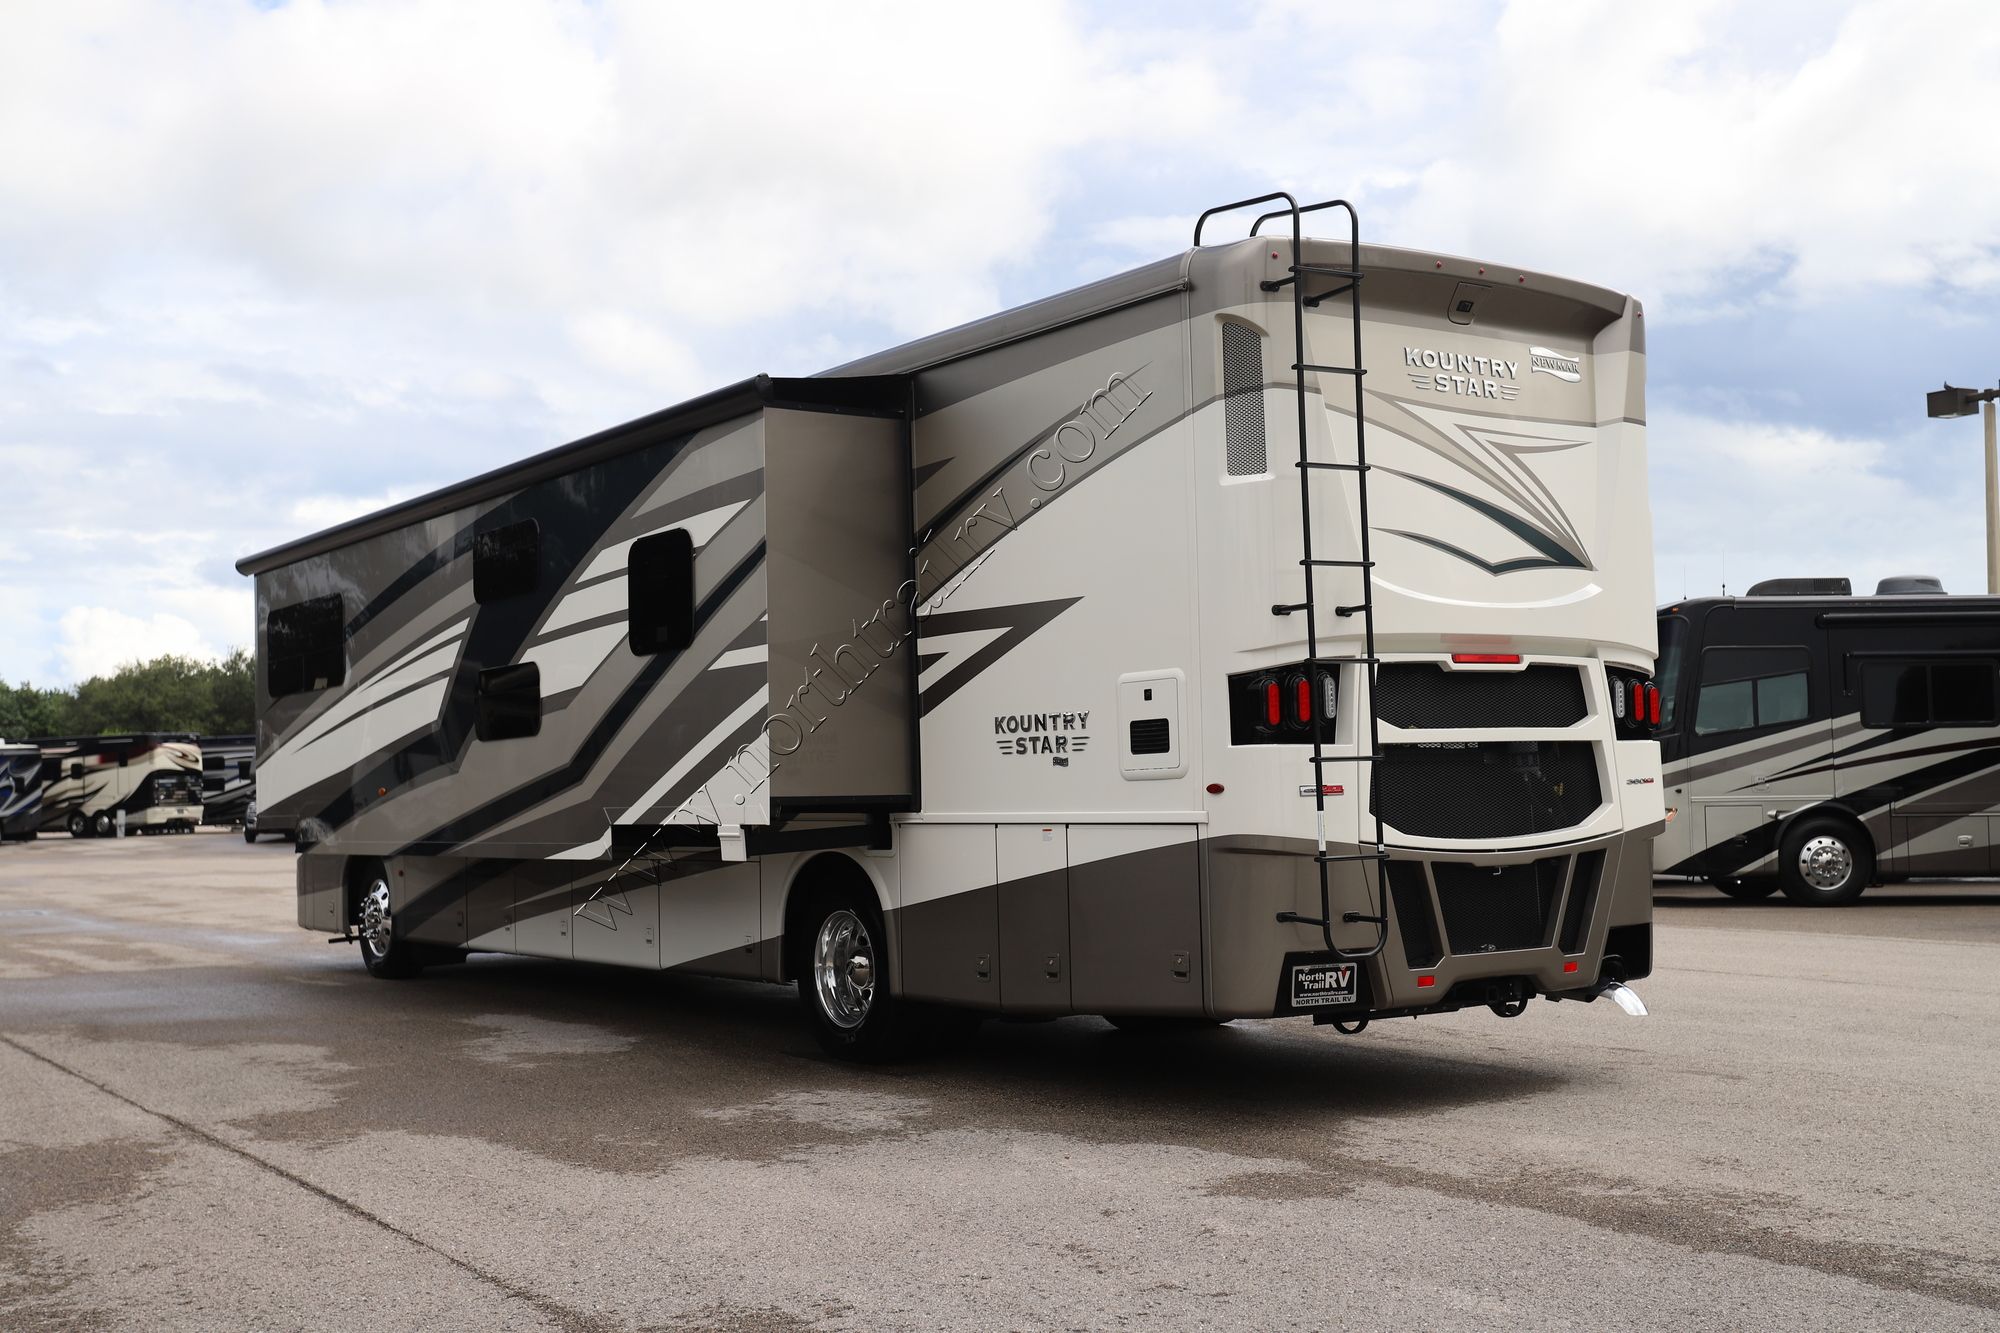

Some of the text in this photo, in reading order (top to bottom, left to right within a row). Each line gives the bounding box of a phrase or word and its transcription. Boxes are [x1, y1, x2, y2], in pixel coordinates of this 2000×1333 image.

[1404, 347, 1519, 380] KOUNTRY
[1531, 356, 1580, 375] NEWMAR
[1434, 373, 1498, 400] STAR
[994, 710, 1090, 735] KOUNTRY
[1016, 735, 1069, 755] STAR
[1299, 973, 1324, 981] North
[1303, 981, 1324, 989] Trail
[1325, 971, 1351, 988] RV
